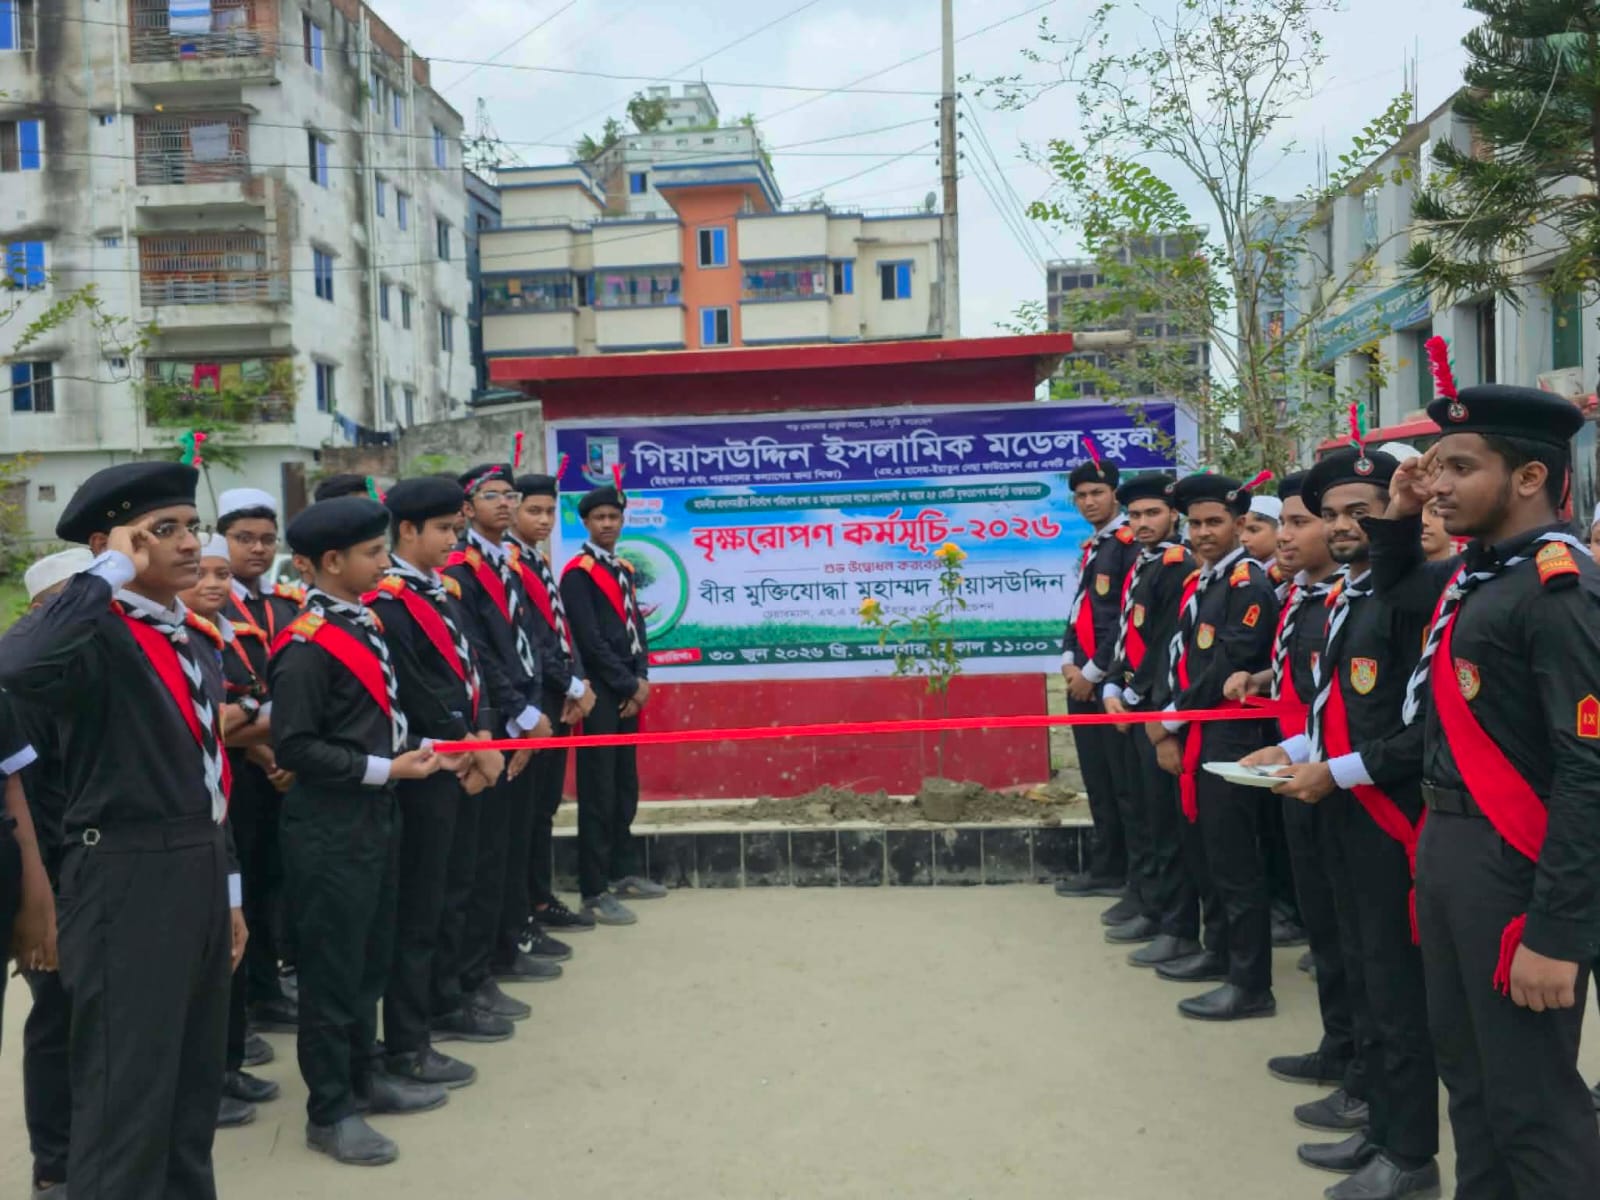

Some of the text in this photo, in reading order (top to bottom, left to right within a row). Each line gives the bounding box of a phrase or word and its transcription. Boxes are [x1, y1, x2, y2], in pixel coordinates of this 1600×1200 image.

[631, 427, 1158, 474] গিয়াসউদ্দিন ইসলামিক মডেল স্কুল
[692, 523, 834, 562] বৃক্ষরোপণ
[824, 563, 845, 573] শুভ
[698, 579, 736, 604] বীর
[743, 578, 848, 607] মুক্তিযোদ্ধা
[709, 653, 735, 662] ৩০
[740, 647, 769, 663] জুন
[775, 648, 824, 659] ২০২৬
